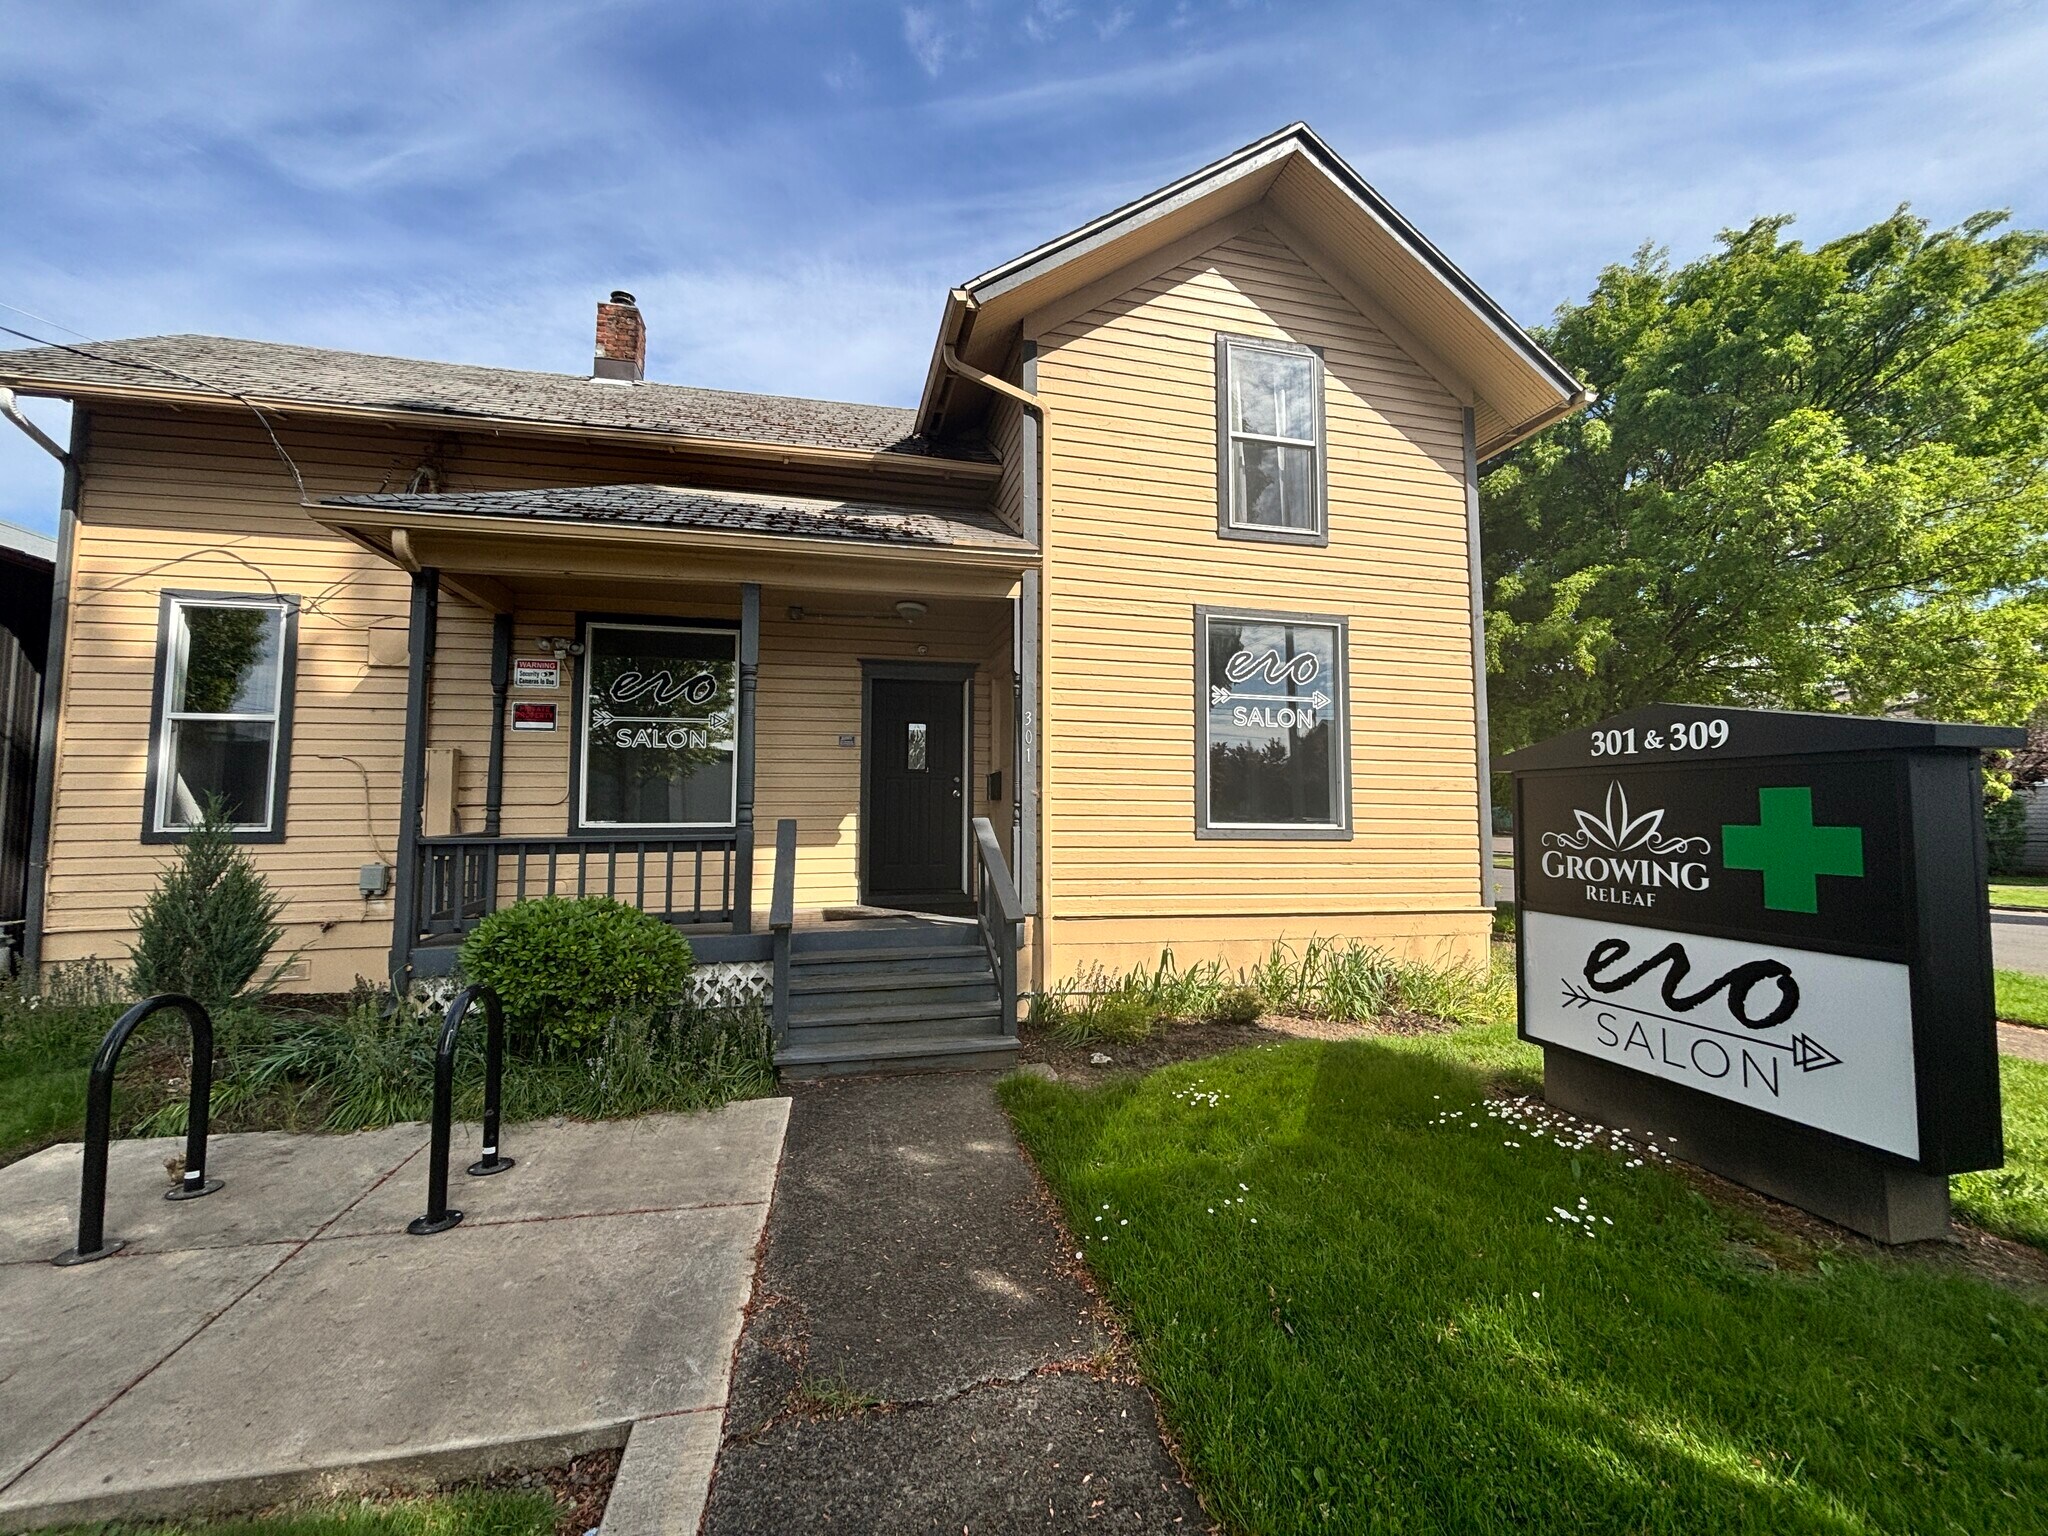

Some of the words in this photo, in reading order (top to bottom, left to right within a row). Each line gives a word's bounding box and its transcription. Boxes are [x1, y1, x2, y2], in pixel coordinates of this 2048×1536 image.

[519, 661, 556, 670] WARNING
[519, 670, 540, 678] Security
[1233, 706, 1314, 729] SALON
[616, 728, 707, 749] SALON
[1024, 711, 1033, 763] 301
[1590, 727, 1640, 757] 301
[1643, 729, 1665, 750] &
[1669, 719, 1730, 751] 309
[1541, 850, 1711, 891] GROWING
[1597, 1012, 1780, 1098] SALON
